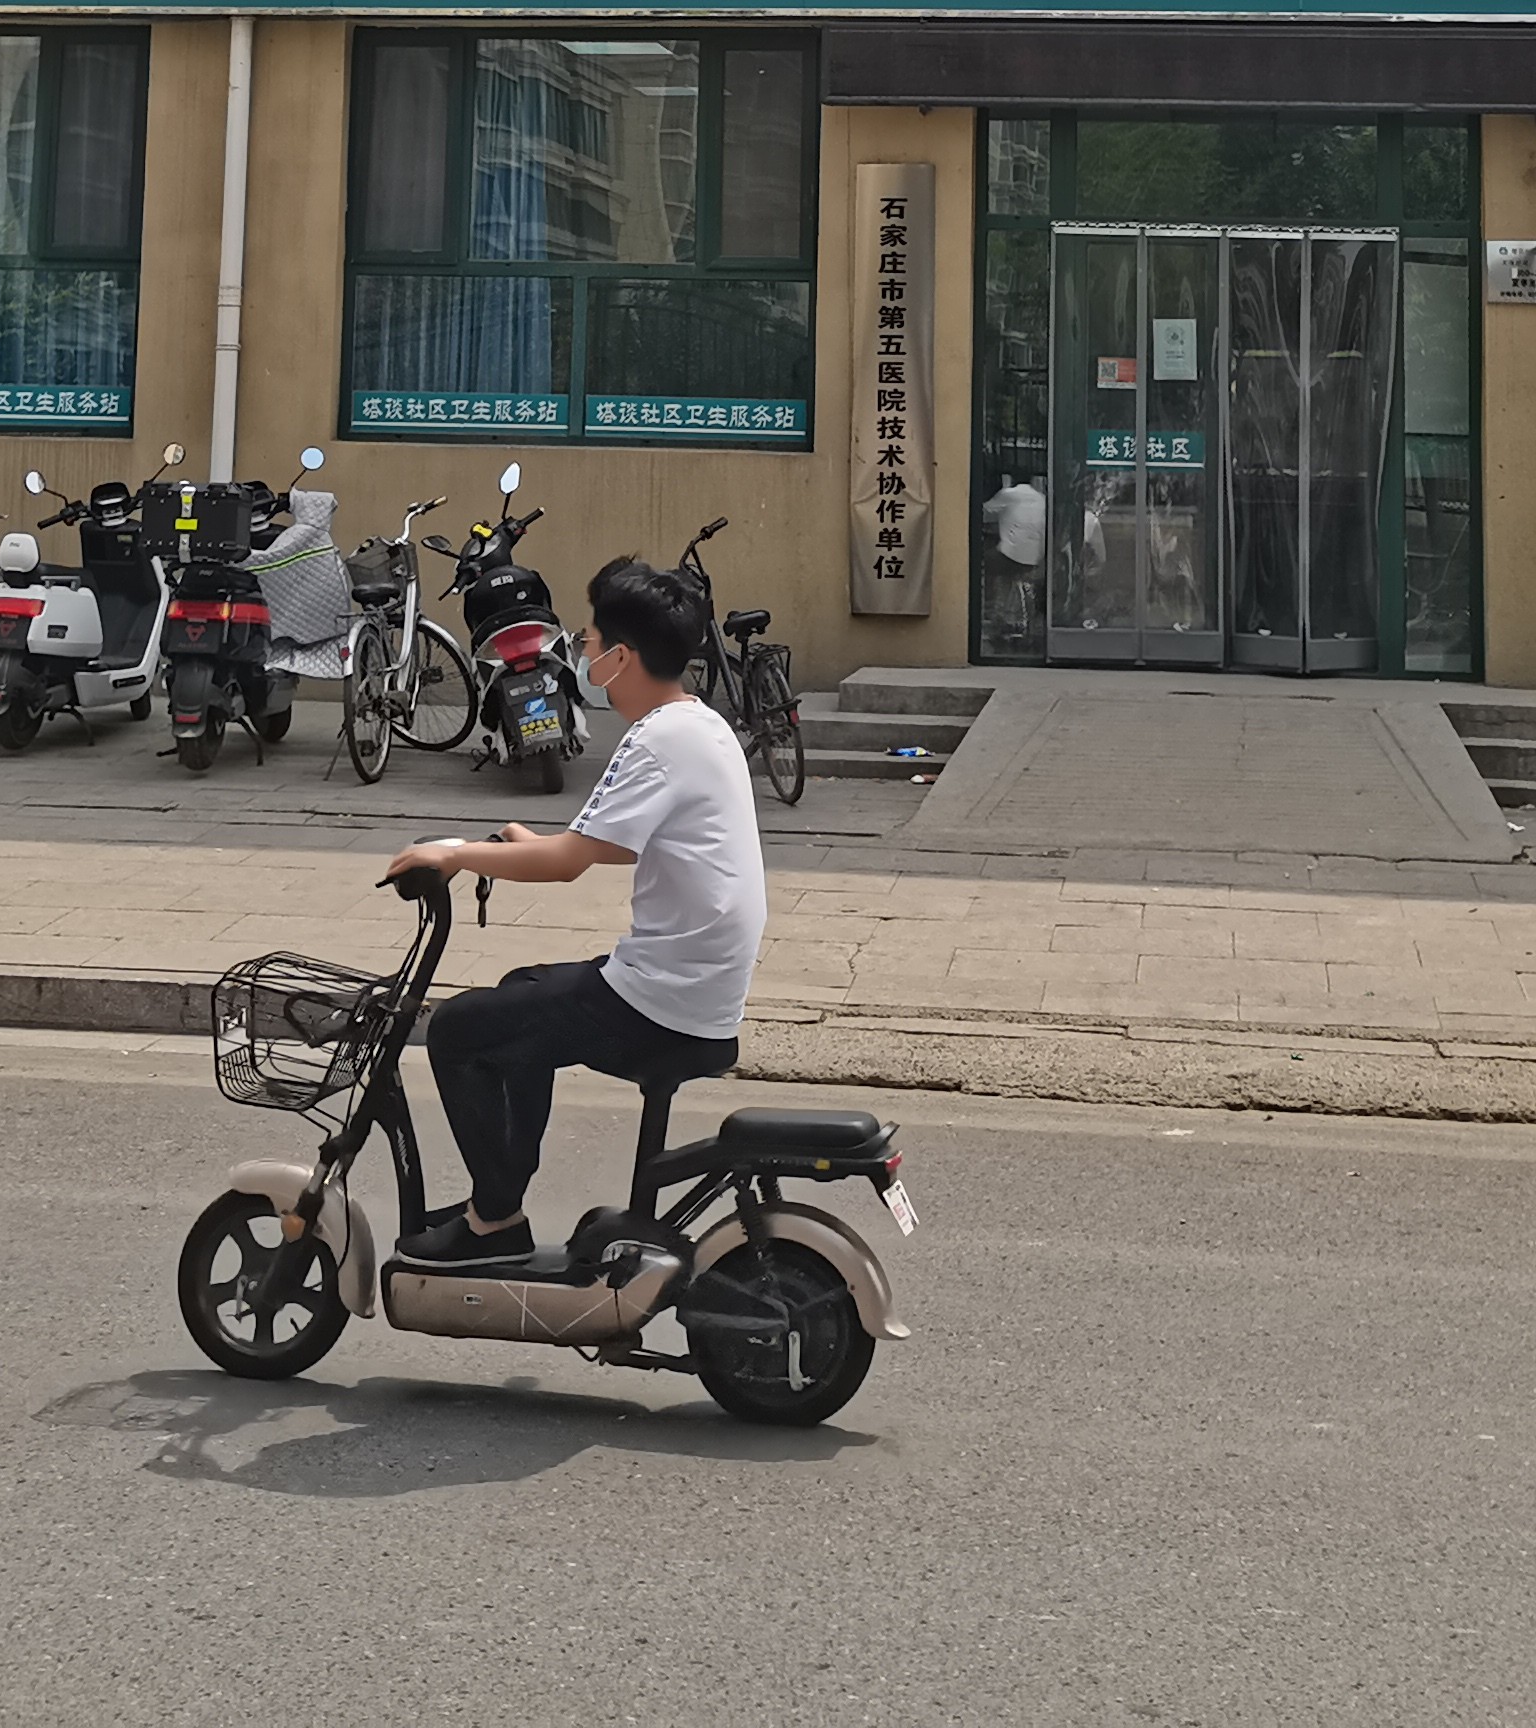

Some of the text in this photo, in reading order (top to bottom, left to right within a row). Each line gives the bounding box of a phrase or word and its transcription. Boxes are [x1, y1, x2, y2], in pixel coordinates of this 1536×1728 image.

[872, 196, 909, 580] 石家庄市第五医院技术协作单位
[362, 396, 558, 422] 塔谈社区卫生服务站
[596, 401, 796, 429] 塔谈社区卫生服务站
